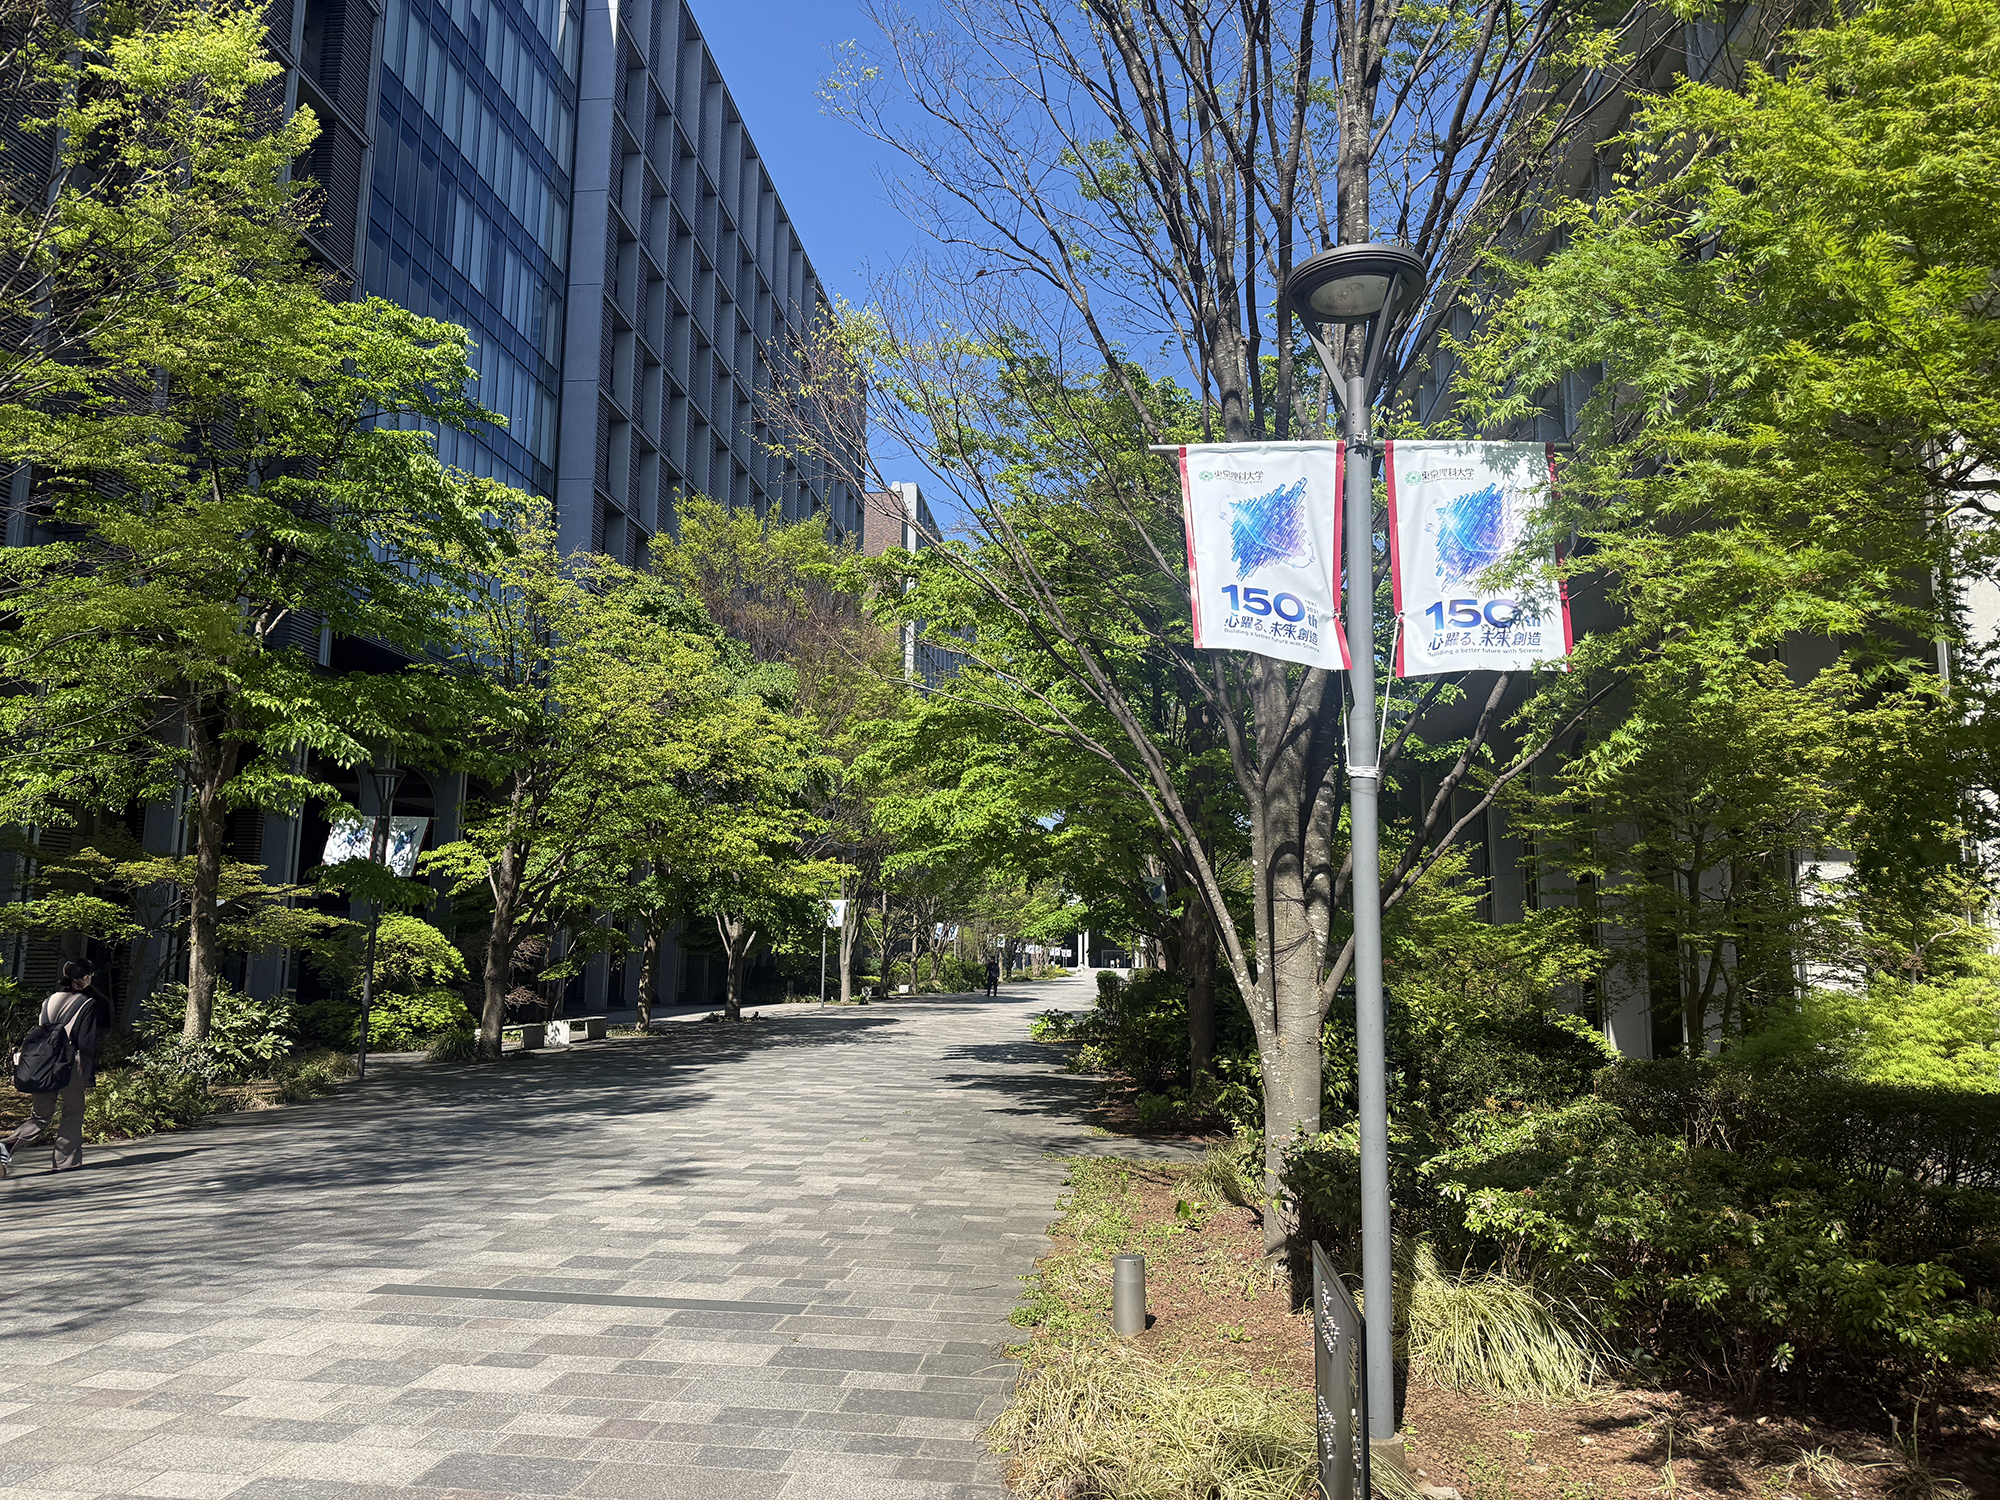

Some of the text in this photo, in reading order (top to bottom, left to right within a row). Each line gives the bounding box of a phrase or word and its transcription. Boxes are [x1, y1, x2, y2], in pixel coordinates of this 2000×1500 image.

[1214, 470, 1264, 481] 東京理科大学
[1422, 467, 1474, 480] 東京理科大学
[1224, 612, 1318, 646] 心躍る、未来創造
[1224, 627, 1249, 636] Building
[1254, 632, 1270, 640] better
[1271, 636, 1289, 645] future
[1427, 631, 1542, 651] 心躍る、未来創造
[1427, 648, 1454, 658] Building
